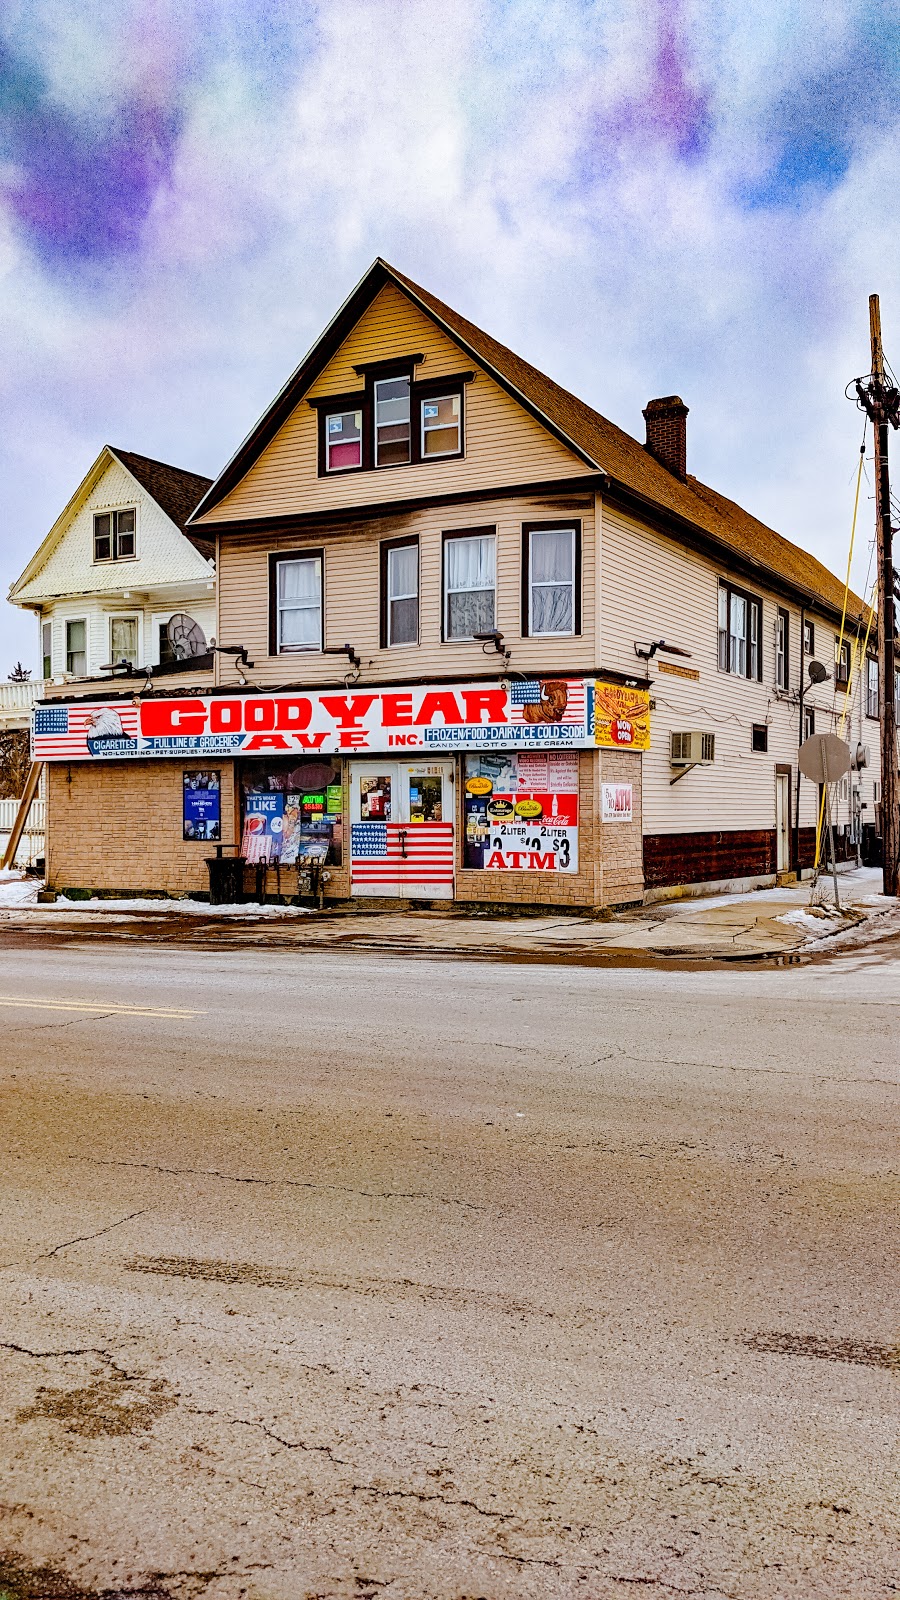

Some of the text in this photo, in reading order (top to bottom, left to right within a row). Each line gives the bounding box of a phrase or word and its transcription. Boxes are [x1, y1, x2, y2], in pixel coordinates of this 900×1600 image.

[537, 725, 560, 738] COLD
[560, 725, 585, 738] SODA
[616, 720, 632, 732] NOW
[153, 735, 239, 748] FULL LINE OF GROCERIES
[241, 731, 423, 750] AVE INC.
[617, 730, 632, 742] OPEN
[93, 740, 136, 750] CIGARETTES
[302, 795, 324, 804] ATM
[247, 801, 277, 811] I LIKE
[486, 851, 557, 870] ATM
